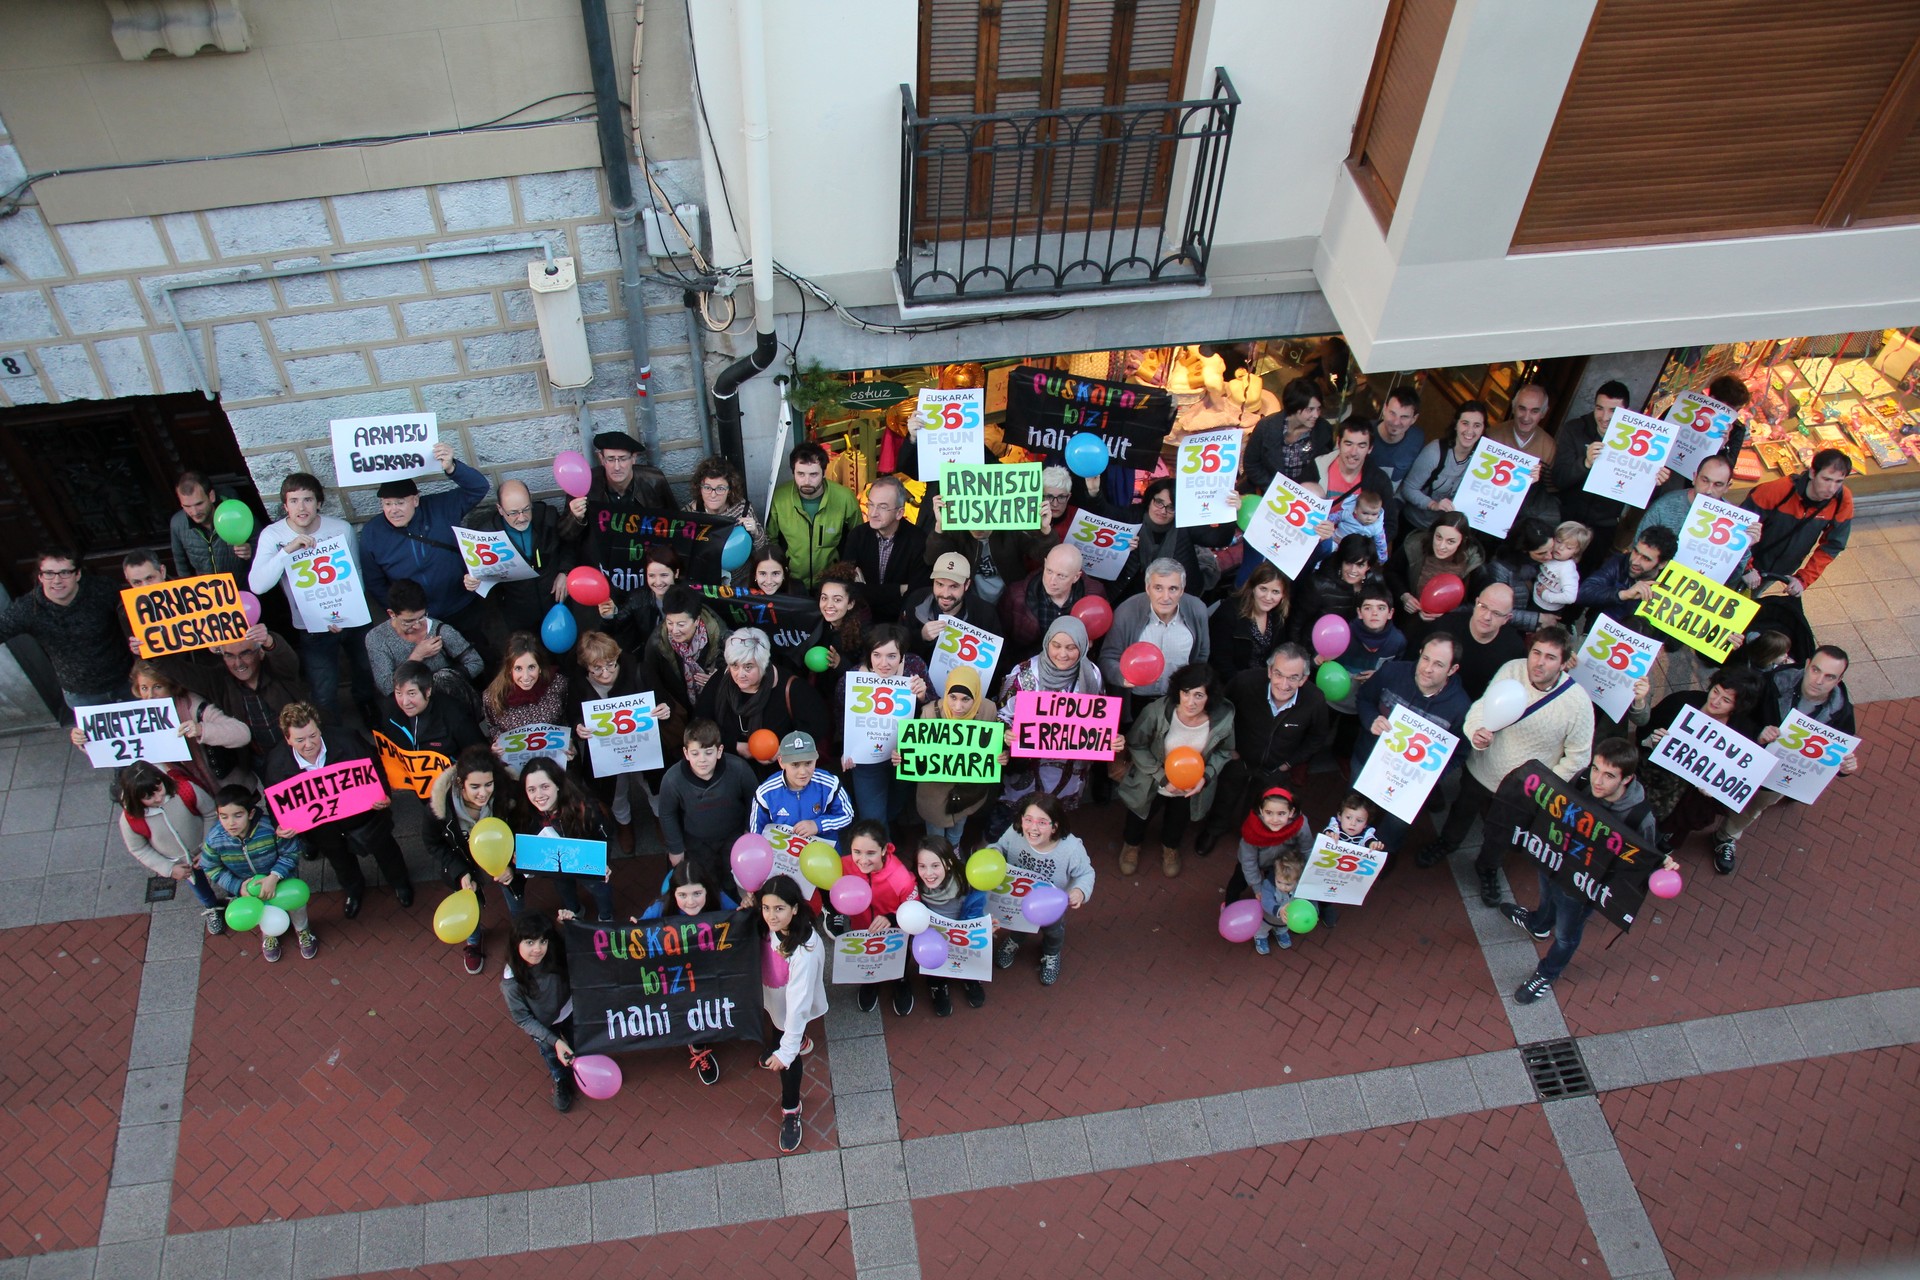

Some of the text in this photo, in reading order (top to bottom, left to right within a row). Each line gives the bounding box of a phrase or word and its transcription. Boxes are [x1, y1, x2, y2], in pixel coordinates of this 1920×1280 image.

[2, 357, 21, 375] 8
[850, 386, 892, 400] eskuz
[926, 394, 974, 402] EUSKARAK
[1033, 373, 1151, 410] euskaraz
[1688, 394, 1732, 414] EUSKARAK
[922, 402, 980, 430] 365
[1063, 404, 1109, 429] bizi
[1622, 414, 1670, 434] EUSKARAK
[1673, 400, 1730, 439] 365
[354, 424, 428, 448] ARNASTU
[927, 431, 974, 445] EGUN
[1102, 434, 1132, 460] ut
[1189, 434, 1234, 444] EUSKARAK
[1608, 422, 1670, 462] 365
[1680, 428, 1712, 450] GUN
[350, 452, 425, 473] EUSKARA
[1181, 443, 1236, 474] 365
[1486, 444, 1532, 466] EUSKARAK
[1606, 452, 1654, 474] EGUN
[946, 470, 1040, 496] ARNASTU
[1186, 475, 1230, 488] EGUN
[1471, 451, 1532, 492] 365
[1282, 480, 1328, 512] EUSKARAK
[1470, 480, 1514, 504] EGUN
[946, 496, 1038, 524] EUSKARA
[1266, 484, 1327, 536] 365
[1702, 501, 1752, 524] EUSKARAK
[460, 532, 500, 542] EUSKARAK
[598, 509, 713, 542] euskaraz
[1072, 520, 1133, 551] 365
[1084, 516, 1132, 532] EUSKARAK
[1265, 511, 1309, 546] EGUN
[1687, 508, 1749, 551] 365
[292, 542, 340, 562] EUSKARAK
[462, 540, 514, 567] 365
[1686, 540, 1735, 564] EGUN
[291, 550, 352, 588] 365
[135, 578, 237, 625] ARNASTU
[304, 582, 352, 602] EGUN
[1658, 570, 1741, 620] LIPDUB
[729, 602, 778, 624] bizi
[144, 610, 250, 654] EUSKARA
[947, 618, 994, 643] EUSKARAK
[1603, 622, 1652, 651] EUSKARAK
[938, 626, 996, 669] 365
[1586, 628, 1652, 679] 365
[856, 676, 907, 686] EUSKARAK
[1584, 658, 1631, 689] EGUN
[592, 698, 646, 712] EUSKARAK
[850, 686, 912, 717] 365
[82, 706, 176, 743] MAIATZAK
[508, 726, 562, 735] EUSKARAK
[591, 706, 654, 737] 365
[900, 722, 994, 748] ARNASTU
[1401, 714, 1449, 744] EUSKARAK
[1796, 718, 1849, 745] EUSKARAK
[111, 738, 145, 761] 27
[504, 732, 565, 752] 365
[600, 732, 650, 748] EGUN
[1384, 720, 1448, 772] 365
[1778, 724, 1848, 767] 365
[900, 748, 994, 777] EUSKARA
[1382, 752, 1427, 784] EGUN
[272, 764, 379, 814] MAIATZAK
[307, 797, 340, 824] 27
[1524, 774, 1640, 864] euskaraz
[768, 829, 809, 858] 36
[1325, 842, 1377, 861] EUSKARAK
[1548, 822, 1594, 866] bizi
[1312, 848, 1378, 876] 365
[1314, 868, 1364, 882] EGUN
[1511, 826, 1613, 908] nahi dut
[846, 930, 900, 938] EUSKARAK
[930, 916, 982, 928] EUSKARAK
[593, 922, 732, 960] euskaraz
[840, 934, 904, 954] 365
[845, 952, 896, 962] EGUN
[640, 962, 696, 996] bizi
[606, 997, 735, 1040] nahi dut
